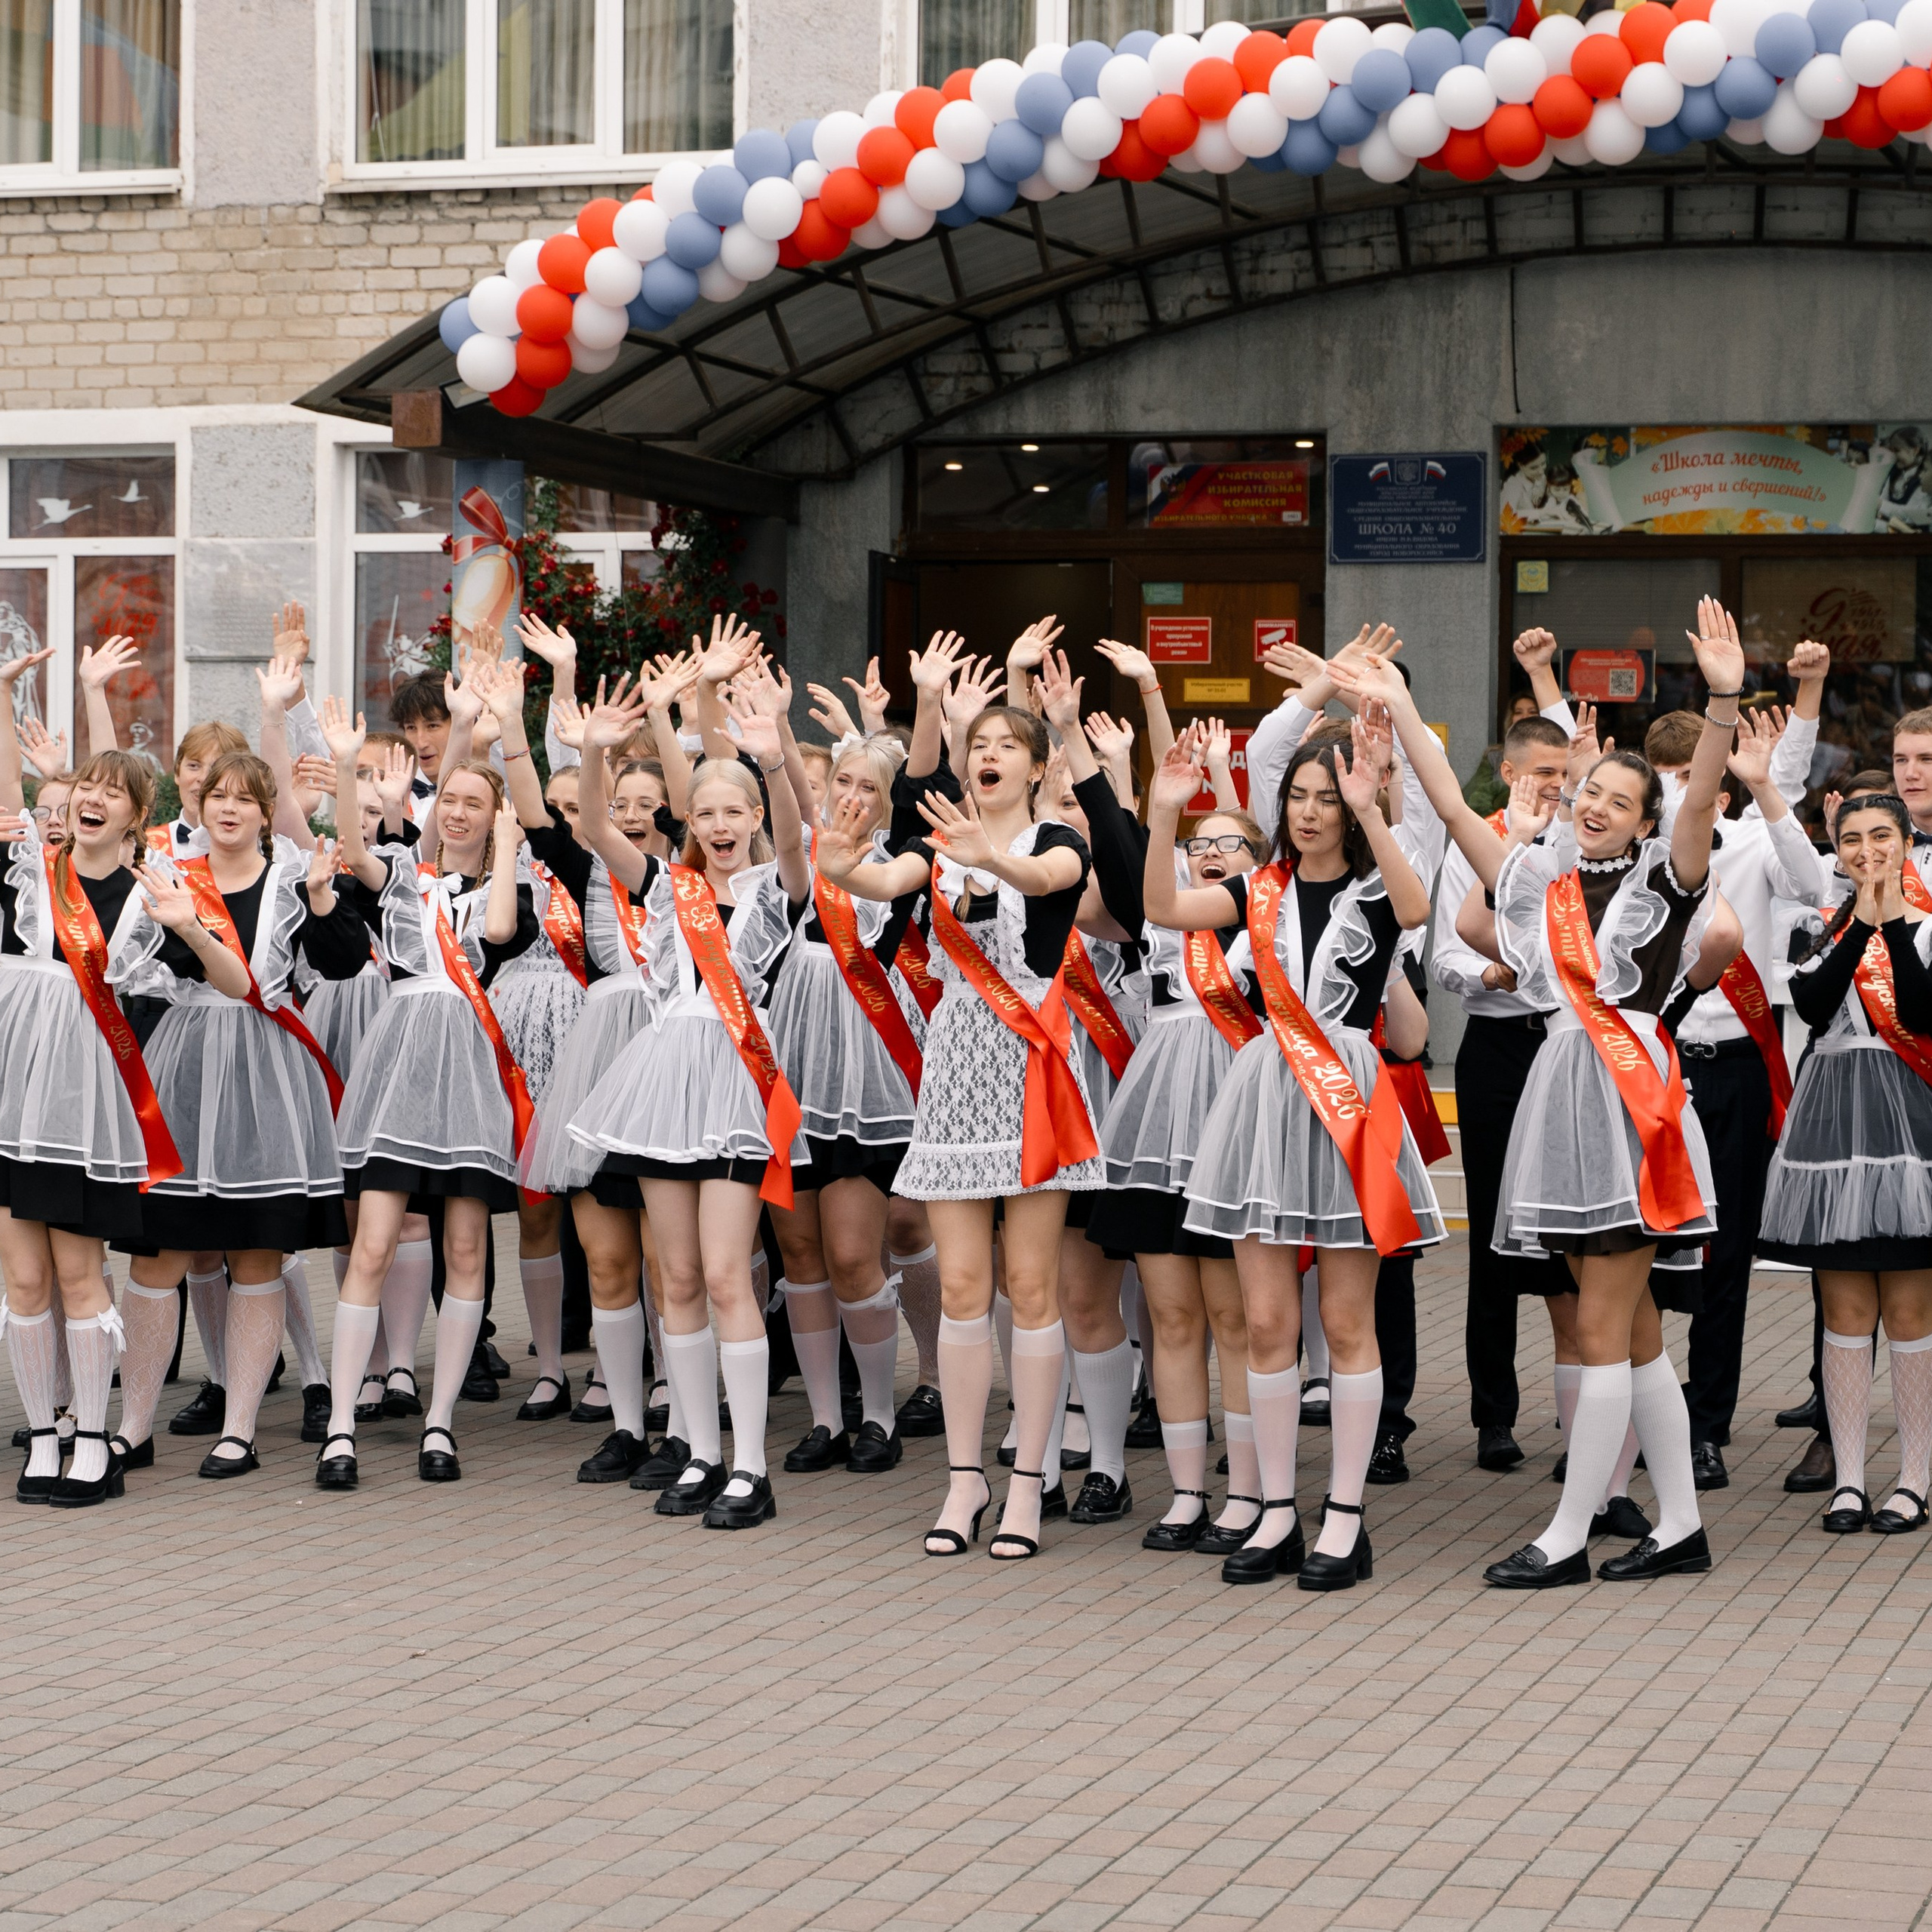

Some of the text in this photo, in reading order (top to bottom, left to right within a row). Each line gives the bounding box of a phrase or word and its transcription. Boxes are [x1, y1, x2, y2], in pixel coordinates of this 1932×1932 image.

[1217, 471, 1294, 480] УЧАСТКОВАЯ
[1651, 451, 1803, 475] «Школа мечты,
[1208, 485, 1302, 494] ИЗБИРАТЕЛЬНАЯ
[1223, 498, 1287, 507] КОМИССИЯ
[1642, 478, 1827, 506] надежды и свершений!»
[1358, 523, 1457, 535] ШКОЛА № 40
[1070, 938, 1096, 989] Александра
[1575, 920, 1601, 982] Письменная
[904, 956, 935, 989] 2026
[1551, 878, 1647, 1072] Выпускница 2026
[855, 975, 891, 1013] 2026
[1220, 971, 1250, 1017] Виктория
[1734, 980, 1768, 1019] 2026
[1254, 921, 1318, 1060] Выпускница
[1310, 1060, 1366, 1121] 2026
[109, 1021, 135, 1060] 2026
